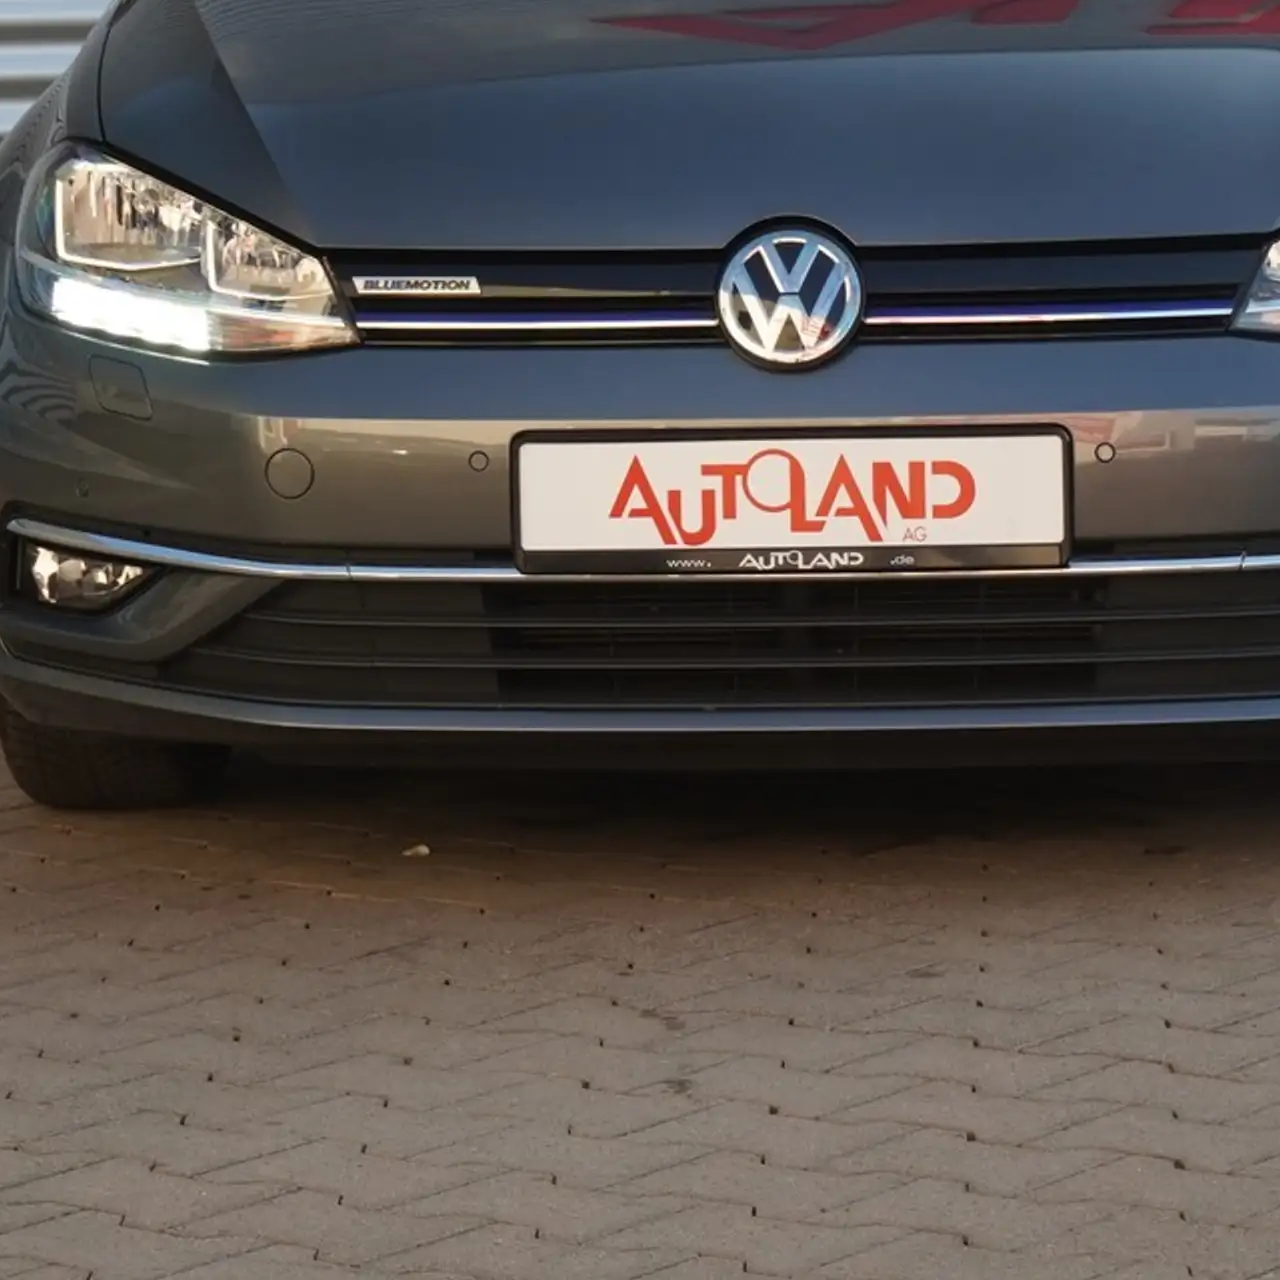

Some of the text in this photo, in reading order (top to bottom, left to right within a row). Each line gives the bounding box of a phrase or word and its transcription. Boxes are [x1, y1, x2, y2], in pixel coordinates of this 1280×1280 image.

[363, 279, 471, 291] BLUEMOTION
[902, 526, 928, 542] AG
[666, 550, 915, 571] www. AUTOLAND .de
